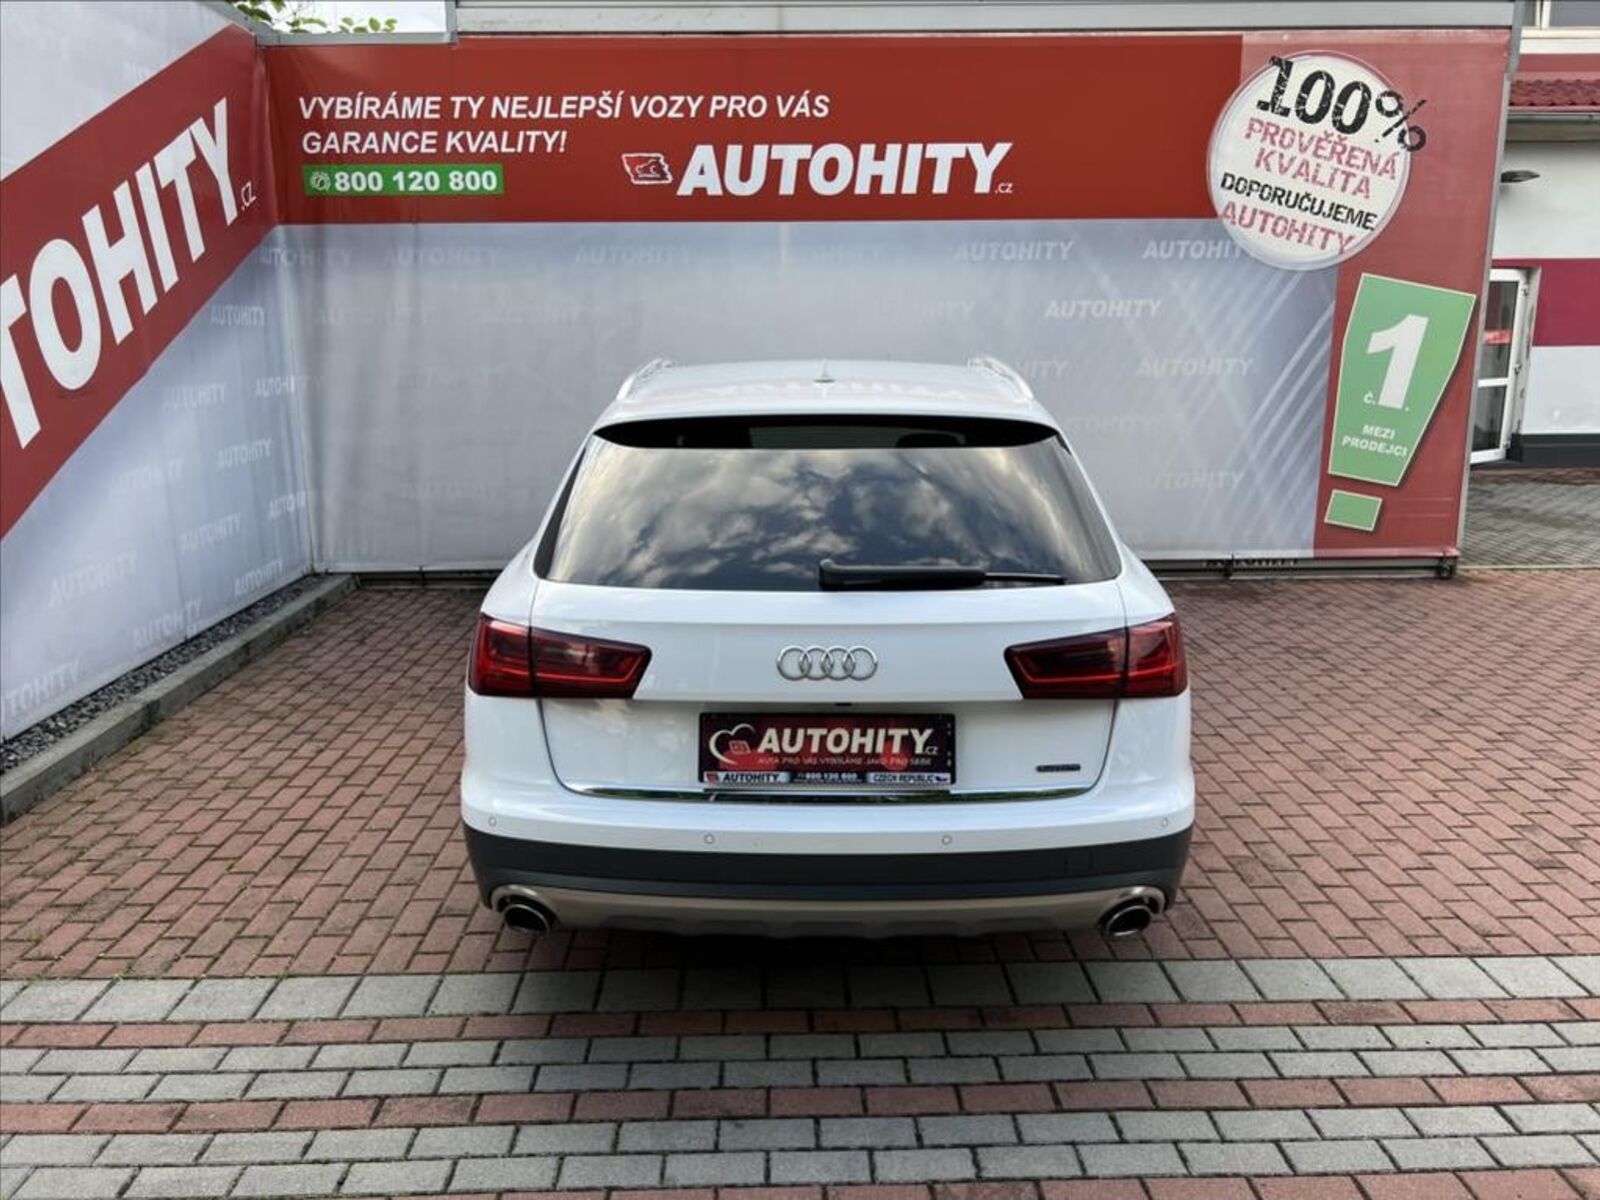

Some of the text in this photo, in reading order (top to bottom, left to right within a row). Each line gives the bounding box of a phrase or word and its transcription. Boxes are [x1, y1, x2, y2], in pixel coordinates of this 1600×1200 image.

[298, 90, 831, 120] VYBÍRÁME TY NEJLEPŠÍ VOZY PRO VÁS
[1256, 56, 1427, 152] 100%
[302, 129, 569, 154] GARANCE KVALITY!
[1245, 117, 1400, 180] PROVĚŘENÁ
[334, 170, 498, 192] 800 120 800
[1254, 148, 1371, 199] KVALITA
[1220, 172, 1378, 232] DOPORUČUJEME
[1221, 201, 1355, 256] AUTOHITY
[953, 240, 1075, 262] AUTOHITY
[1043, 299, 1162, 319] AUTOHITY
[1362, 424, 1395, 440] MEZI
[1341, 435, 1409, 457] PRODEJCI
